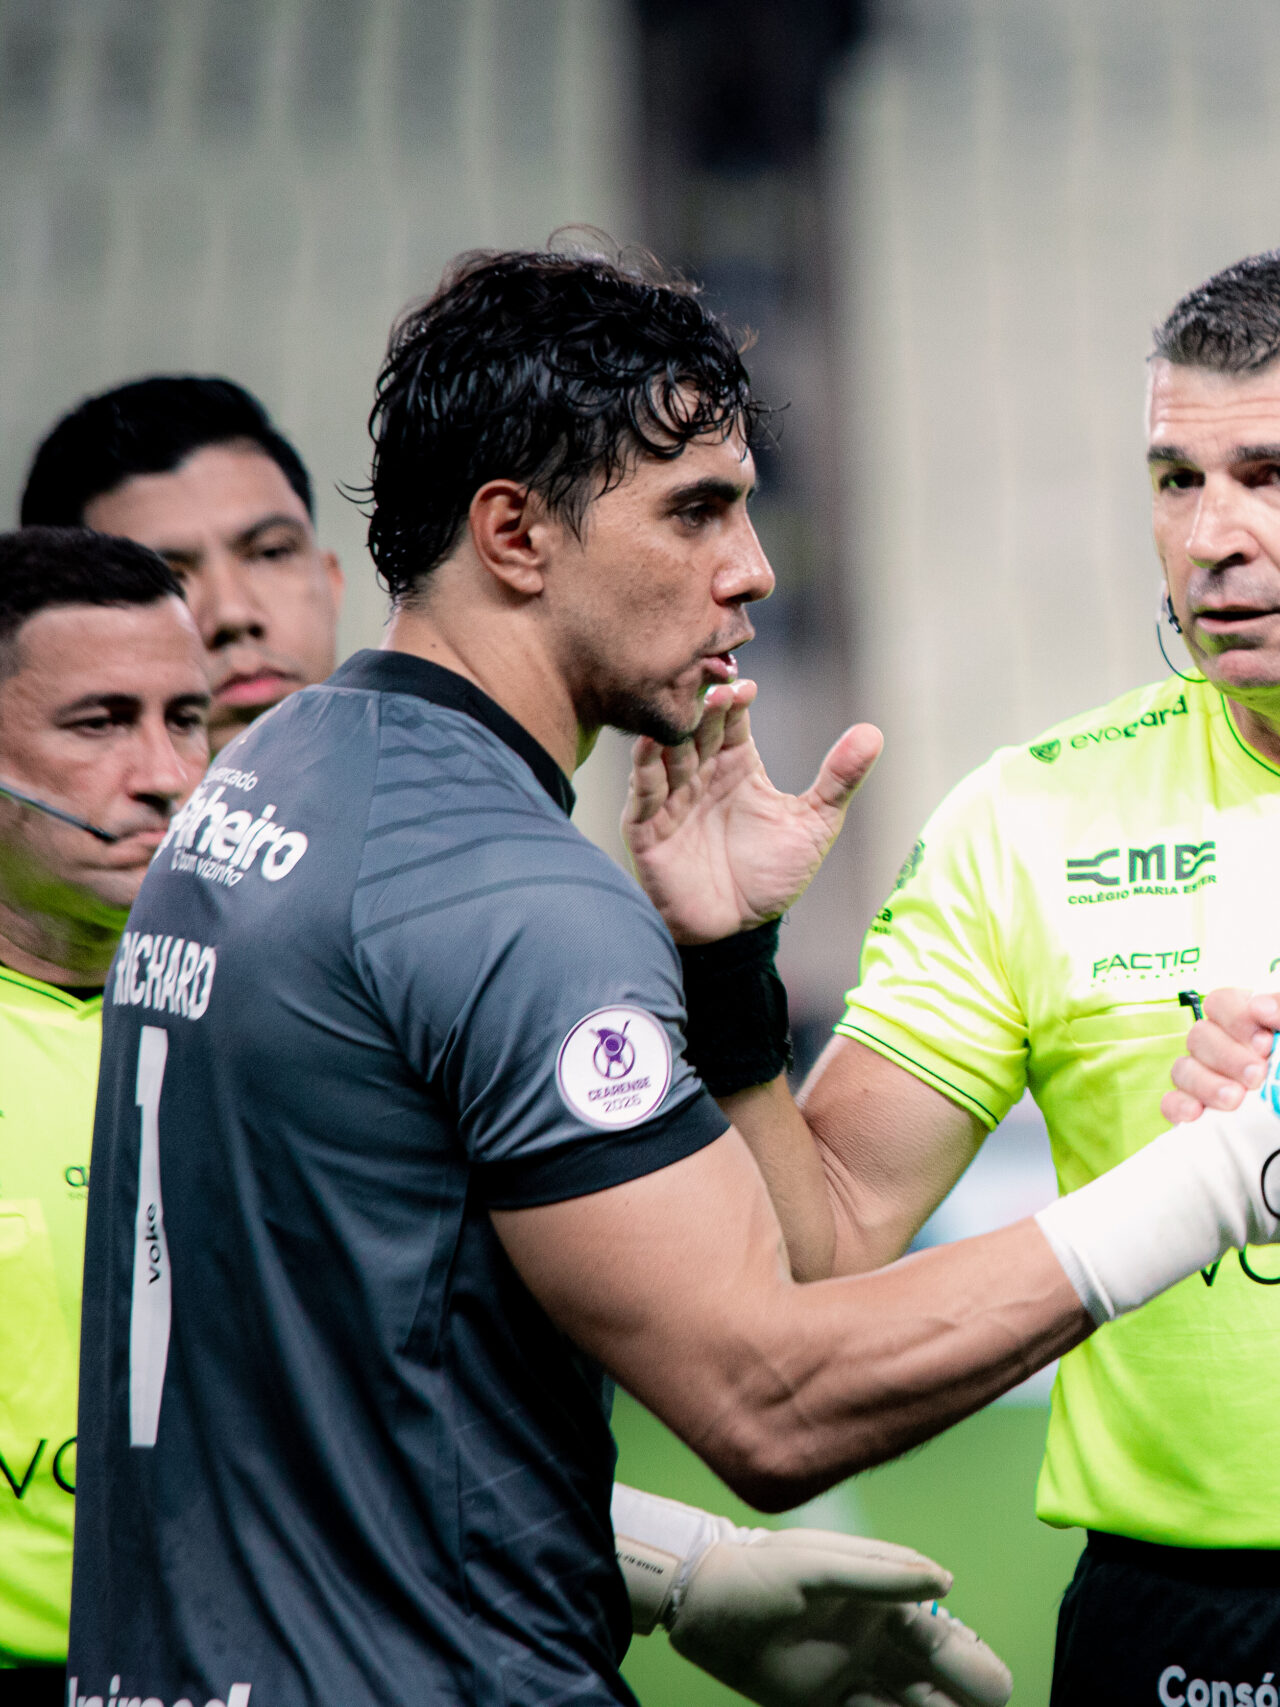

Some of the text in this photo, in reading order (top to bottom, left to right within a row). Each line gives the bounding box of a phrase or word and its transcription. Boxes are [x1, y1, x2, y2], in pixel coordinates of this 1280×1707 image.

[1133, 885, 1178, 896] MARIA
[113, 931, 217, 1021] RICHARD
[587, 1076, 651, 1102] CEARENSE
